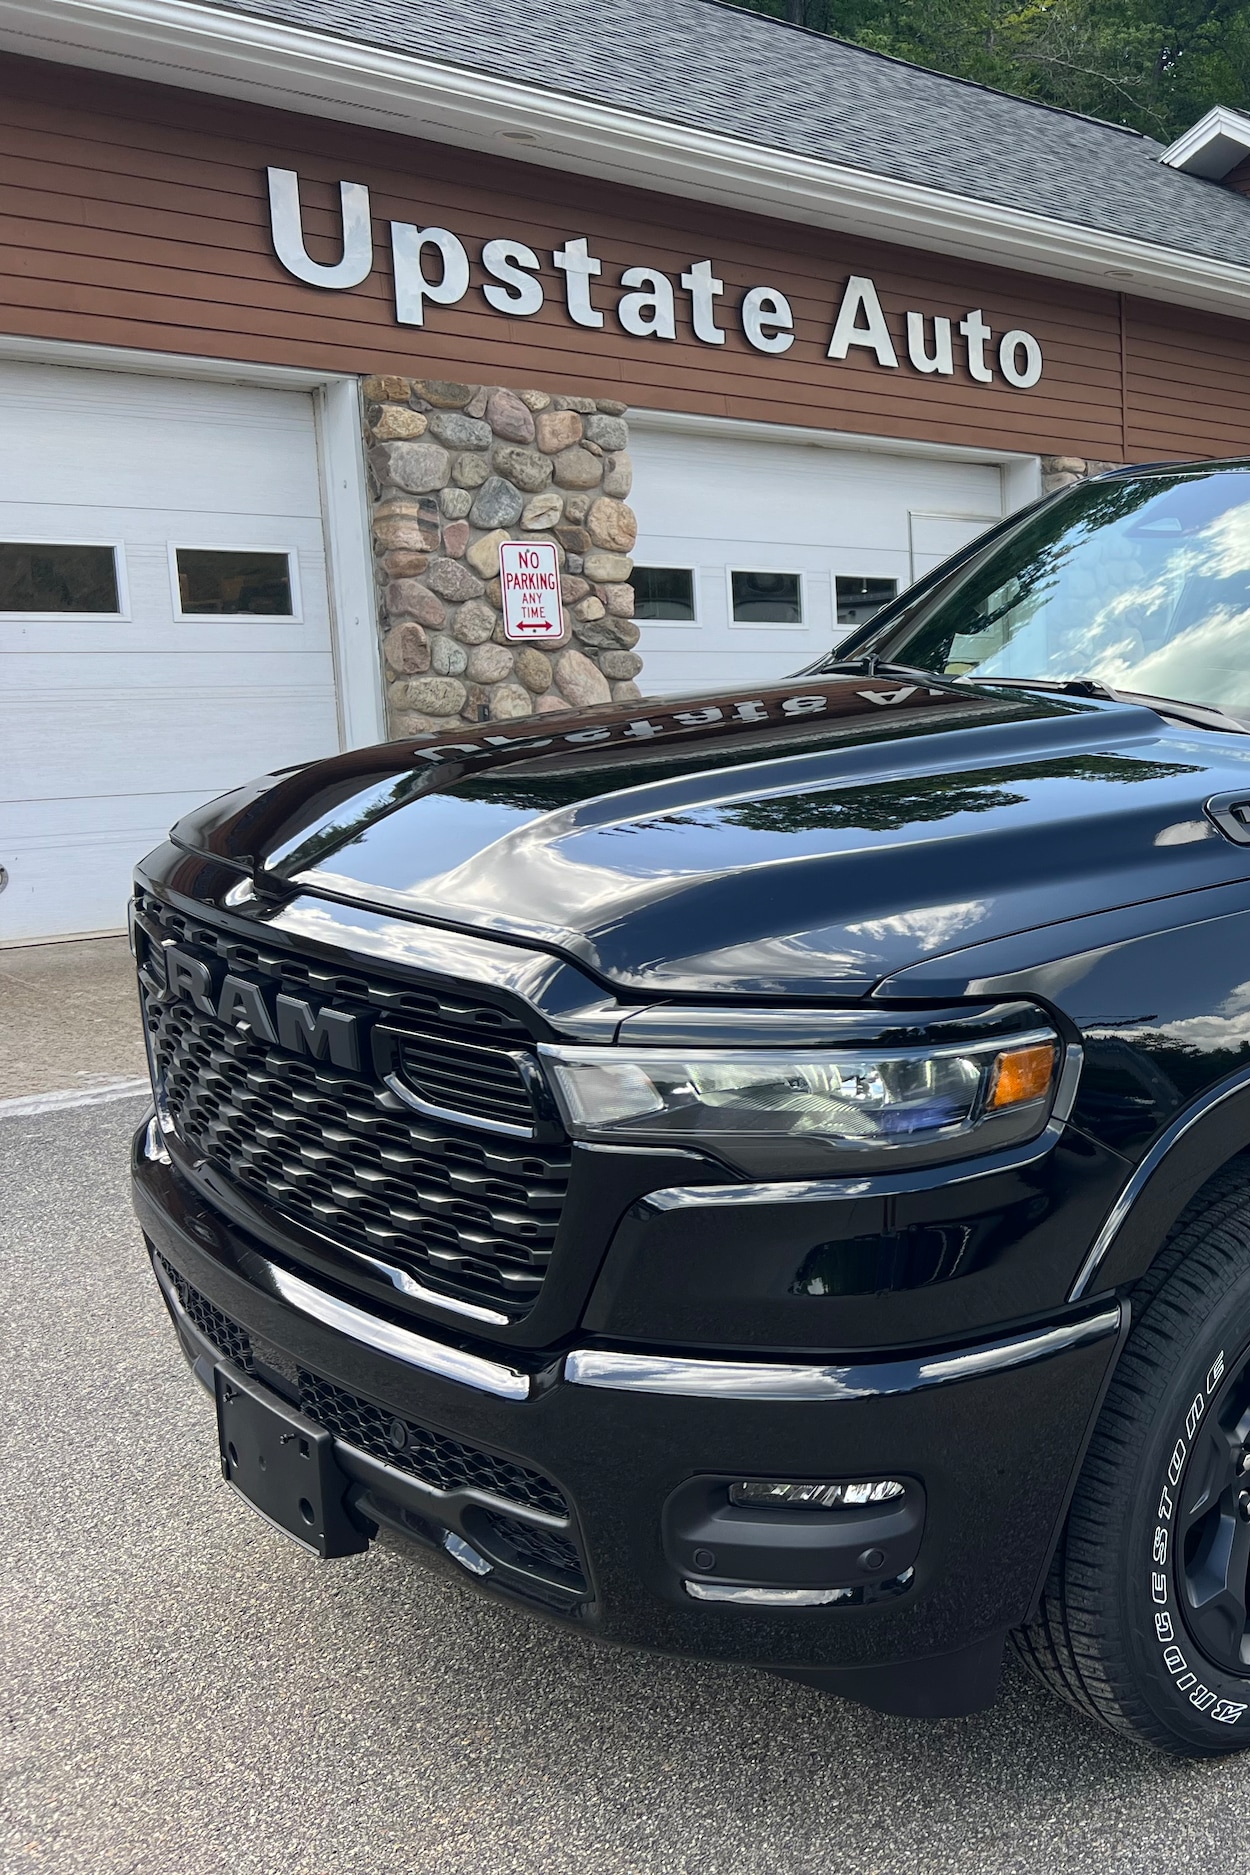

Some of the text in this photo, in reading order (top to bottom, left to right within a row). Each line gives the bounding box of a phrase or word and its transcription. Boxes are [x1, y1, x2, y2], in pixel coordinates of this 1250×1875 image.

[266, 165, 1044, 389] Upstate Auto
[518, 551, 540, 569] NO
[506, 572, 556, 590] PARKING
[522, 592, 543, 604] ANY
[521, 606, 546, 618] TIME
[165, 946, 363, 1073] RAM
[1151, 1350, 1248, 1725] BRIDGESTONE
